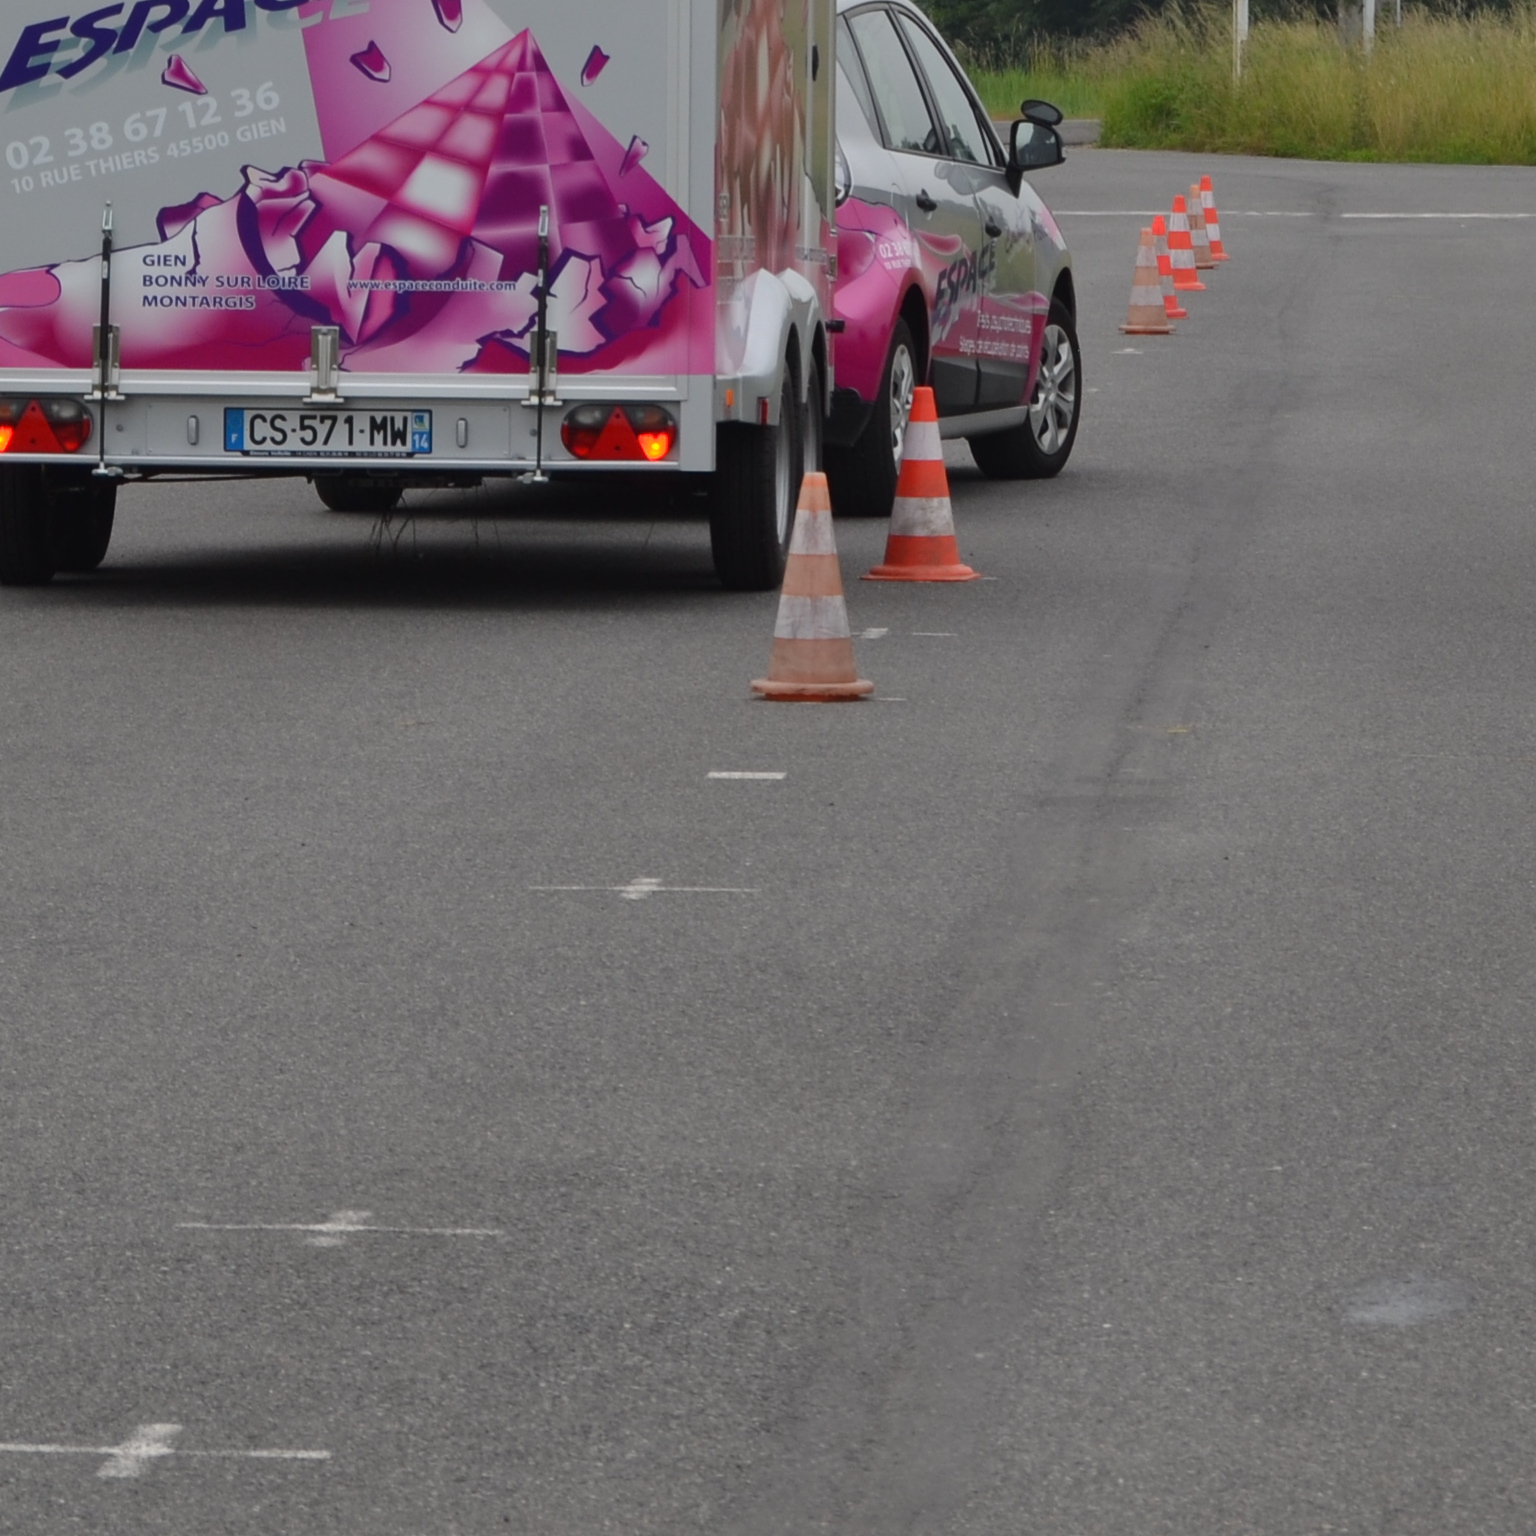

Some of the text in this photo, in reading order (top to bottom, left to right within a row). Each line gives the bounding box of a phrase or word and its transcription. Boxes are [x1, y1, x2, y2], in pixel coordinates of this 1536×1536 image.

[5, 80, 281, 171] 02 38 67 12 36
[10, 116, 288, 195] 10 RUE THIERS 45500 GIEN
[142, 254, 187, 267] GIEN
[142, 274, 311, 290] BONNY SUR LOIRE
[347, 277, 517, 293] www.espaceconduite.com
[142, 295, 256, 309] MONTARGIS
[249, 414, 408, 446] CS-571-MW
[230, 434, 238, 444] F
[413, 434, 429, 449] 14
